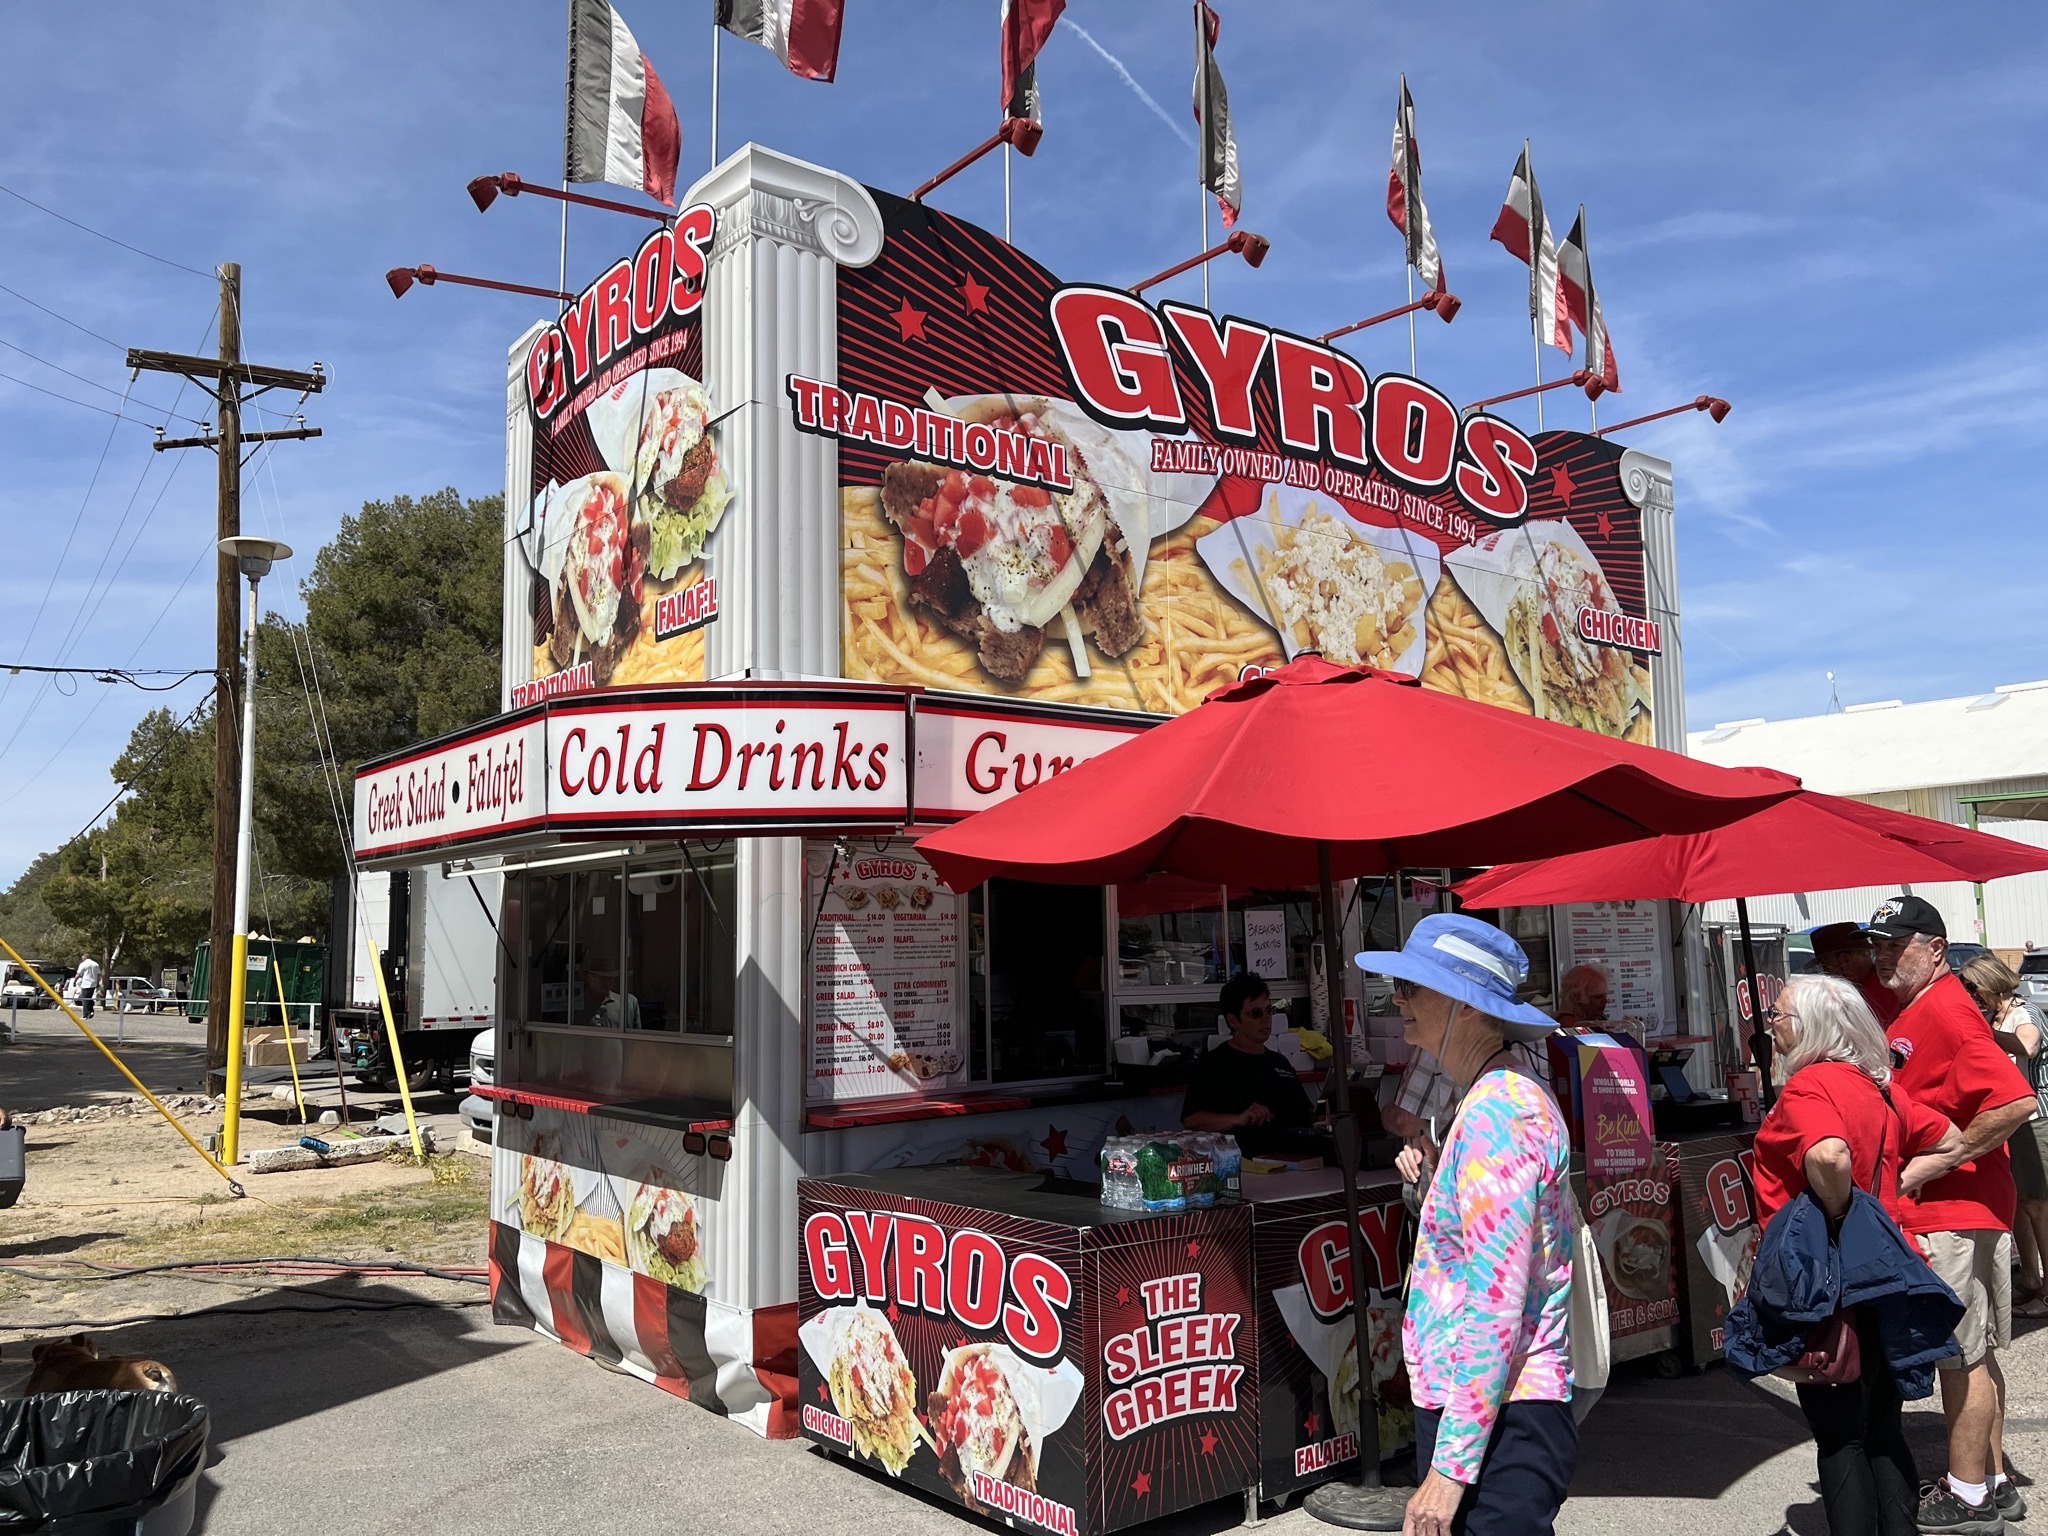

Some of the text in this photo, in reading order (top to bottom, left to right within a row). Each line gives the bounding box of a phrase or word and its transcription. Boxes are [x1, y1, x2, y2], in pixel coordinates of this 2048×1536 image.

[526, 204, 716, 419] GYROS
[551, 399, 574, 440] FAMILY
[574, 380, 597, 415] OWNED
[597, 369, 612, 395] AND
[612, 346, 647, 384] OPERATED
[648, 334, 670, 362] SINCE
[670, 328, 688, 353] 1994
[1052, 288, 1538, 520] GYROS
[789, 373, 1074, 493] TRADITIONAL
[1152, 441, 1477, 545] FAMILY OWNED AND OPERATED SINCE 1994
[656, 577, 718, 636] FALAFEL
[1578, 606, 1661, 652] CHICKEN
[512, 661, 595, 710] TRADITIONAL
[559, 718, 889, 798] Cold Drinks
[368, 737, 524, 835] Greek Salad Falafel
[855, 859, 917, 879] GYROS
[816, 913, 855, 922] TRADITIONAL
[893, 913, 926, 921] VEGETARIAN
[1247, 923, 1284, 937] BREAKFAST
[816, 936, 840, 945] CHICKEN
[893, 935, 915, 943] FALAFEL
[816, 964, 847, 973] SANDWICH
[849, 963, 871, 972] COMBO
[893, 980, 948, 990] EXTRA CONDIMENTS
[816, 992, 835, 1001] GREEK
[836, 991, 855, 1000] SALAD
[1737, 972, 1785, 1021] GRO
[816, 1023, 838, 1032] FRENCH
[840, 1022, 855, 1031] FRIES
[893, 1011, 915, 1019] DRINKS
[816, 1036, 835, 1044] GREEK
[836, 1035, 852, 1043] FRIES
[815, 1068, 843, 1077] BAKLAVA
[1592, 1078, 1635, 1087] WHOLE WORLD
[1615, 1087, 1639, 1095] STAFFED.
[1595, 1113, 1641, 1146] Be Kind
[1593, 1157, 1646, 1167] WHO SHOWED UP
[1606, 1148, 1636, 1157] TO THOSE
[1605, 1167, 1614, 1176] TO
[1590, 1179, 1670, 1216] GYROS
[804, 1210, 1072, 1359] GYROS
[1140, 1272, 1202, 1321] THE
[1609, 1298, 1680, 1332] TER & SODA
[1104, 1313, 1242, 1386] SLEEK
[1103, 1364, 1245, 1441] GREEK
[802, 1404, 853, 1445] CHICKEN
[1295, 1432, 1357, 1477] FALAFEL
[973, 1470, 1079, 1536] TRADITIONAL
